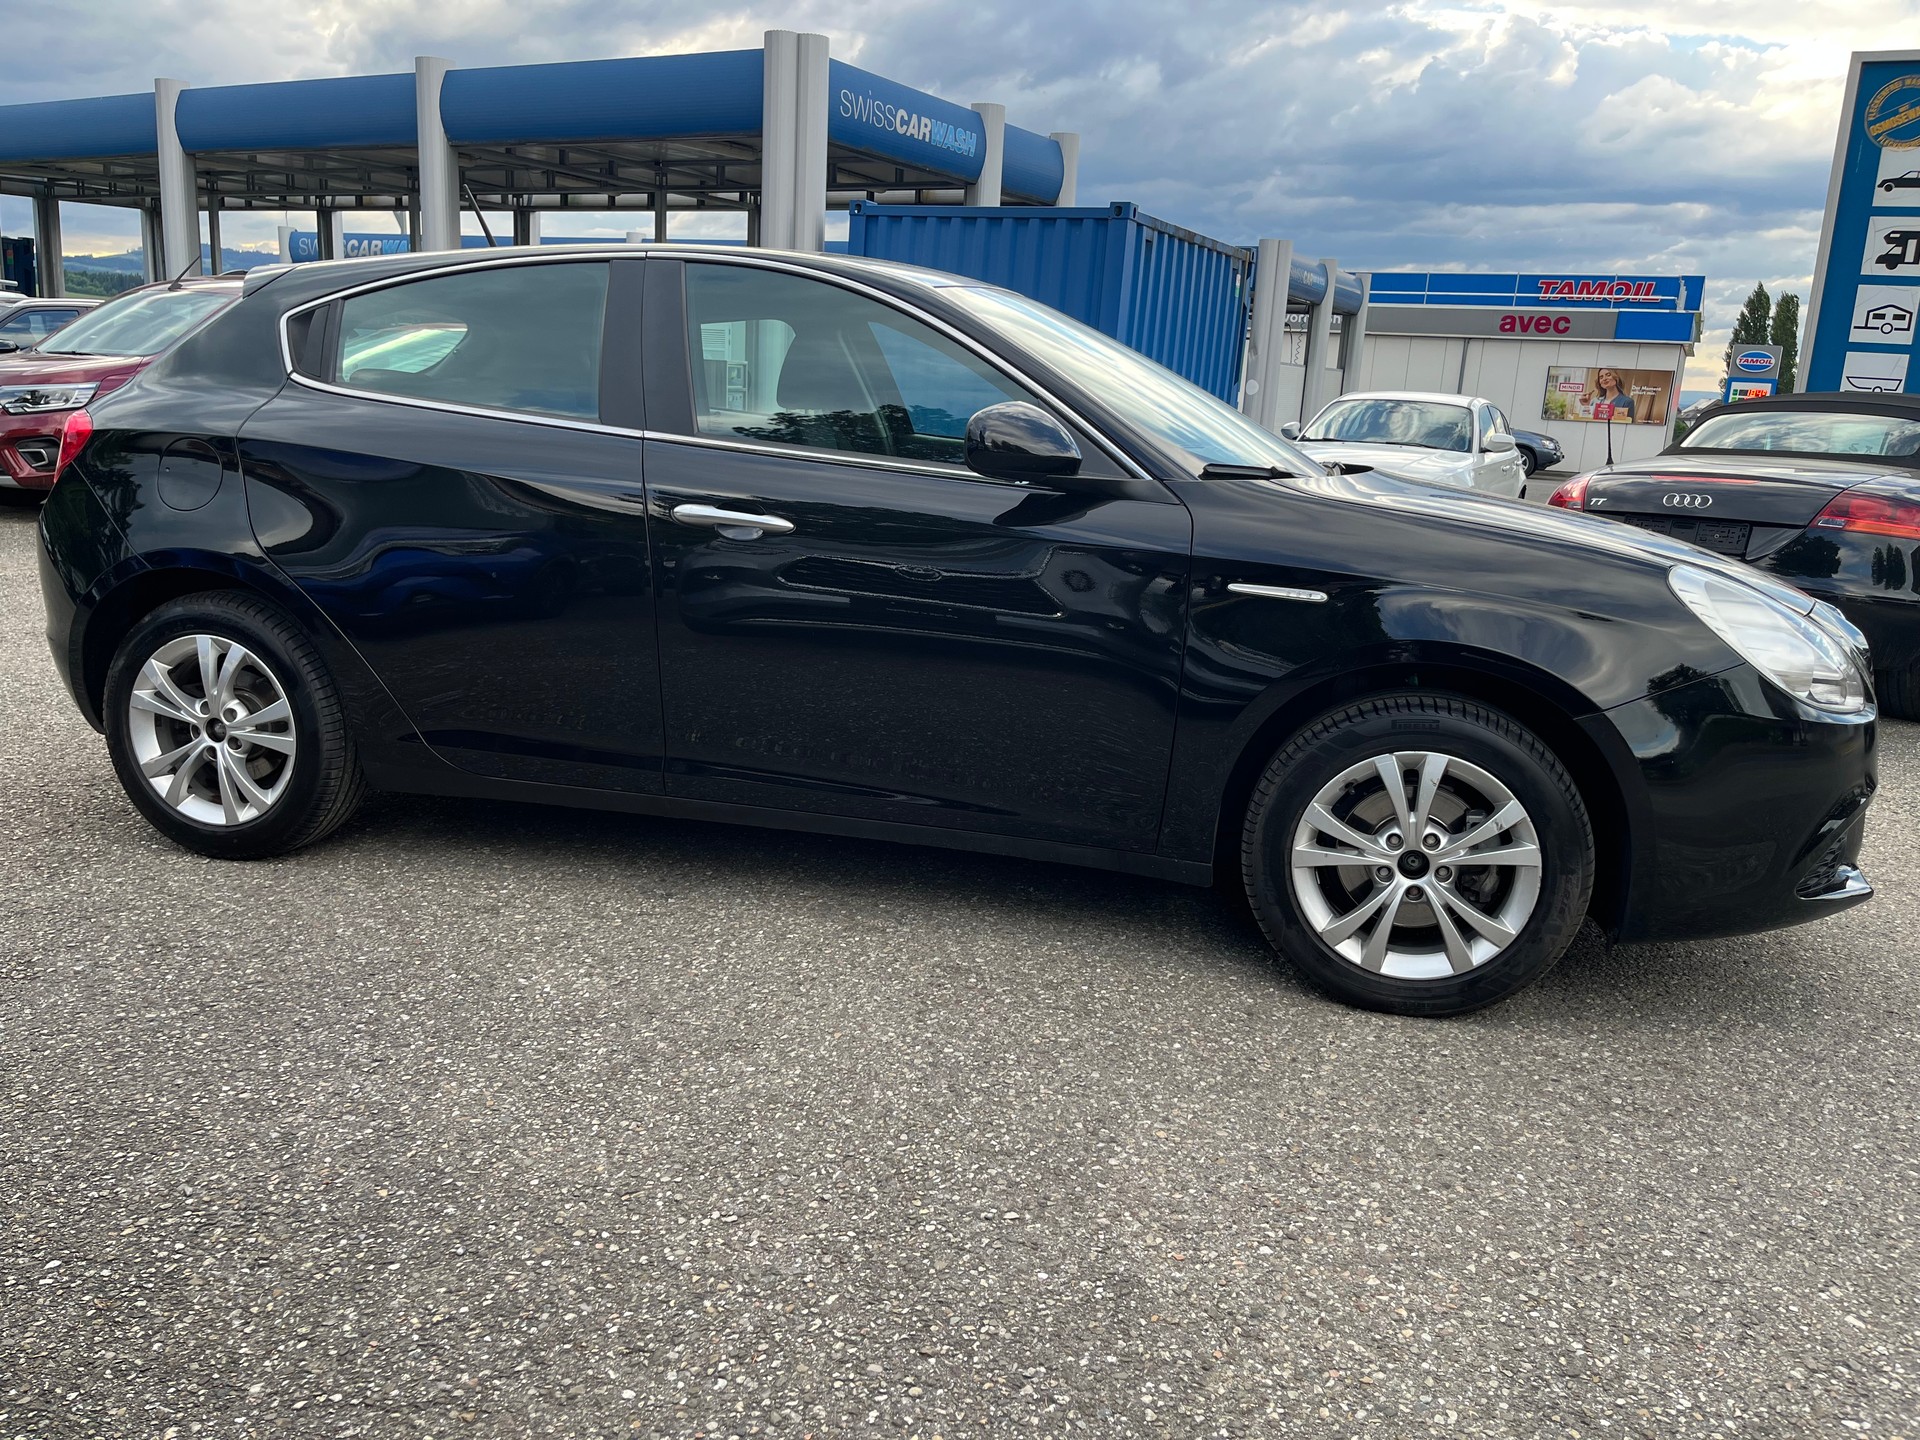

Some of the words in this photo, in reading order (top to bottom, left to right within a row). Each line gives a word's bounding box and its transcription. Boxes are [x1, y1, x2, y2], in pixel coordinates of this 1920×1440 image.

[1538, 279, 1662, 303] TAMOIL
[1500, 314, 1571, 334] avec
[1738, 357, 1774, 365] TAMOIL
[1590, 497, 1607, 506] TT
